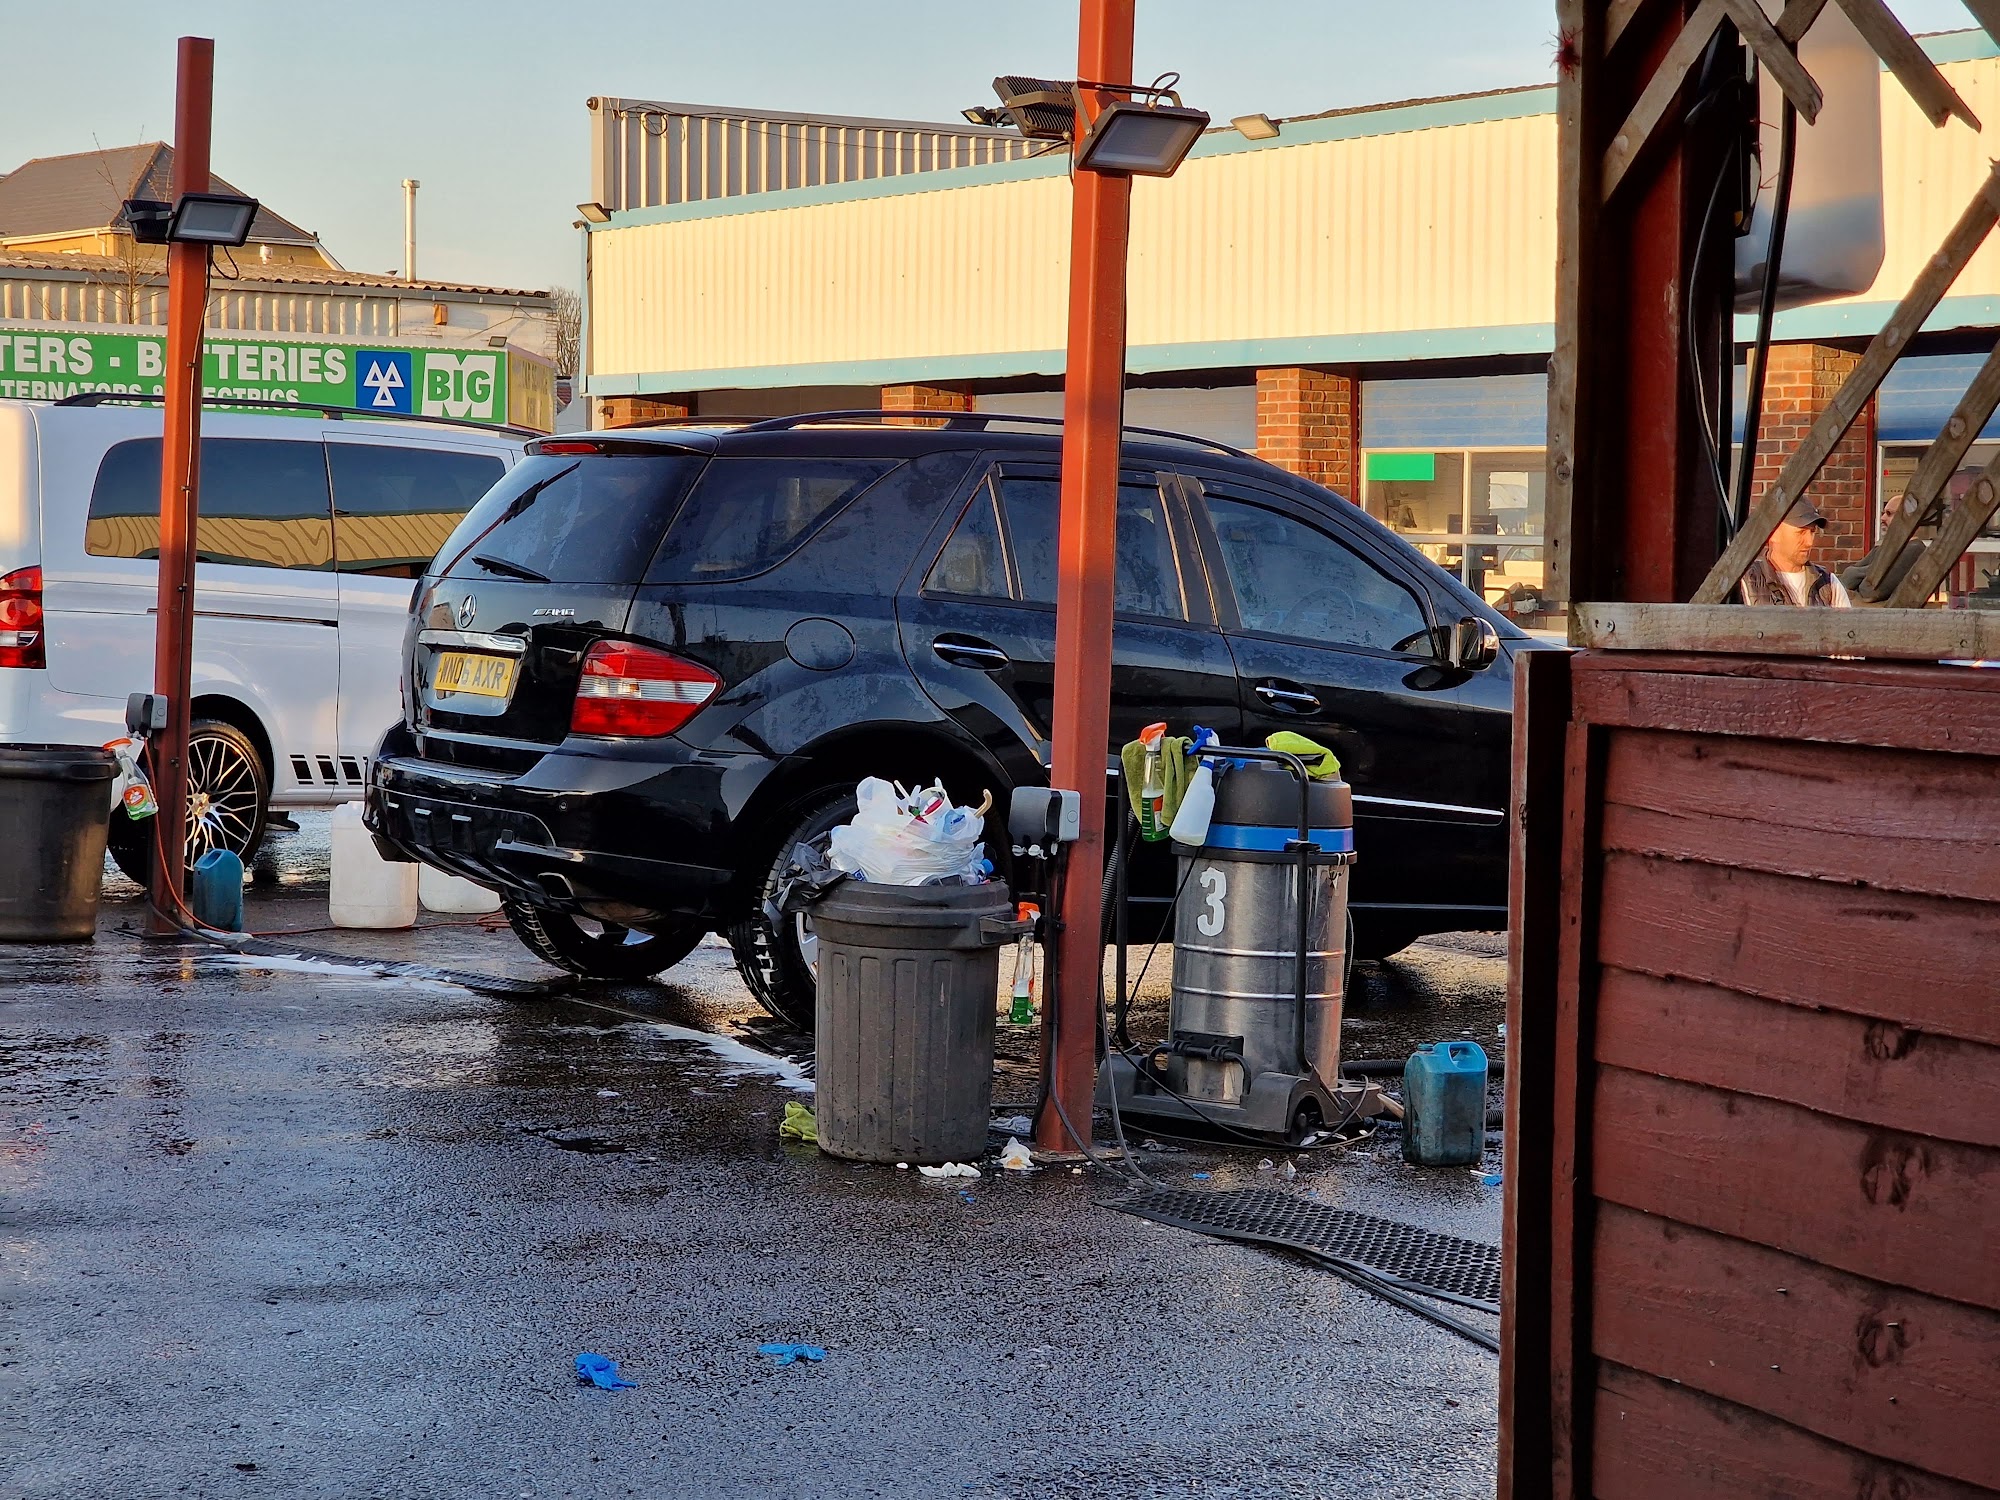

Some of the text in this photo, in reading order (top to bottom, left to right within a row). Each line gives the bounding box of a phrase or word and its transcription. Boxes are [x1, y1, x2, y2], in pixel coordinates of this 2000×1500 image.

[137, 340, 347, 385] BTERIES
[203, 386, 299, 411] ECTRICS
[427, 368, 491, 404] BIG
[542, 608, 575, 616] AMG
[472, 659, 506, 690] AXR
[1197, 866, 1227, 937] 3
